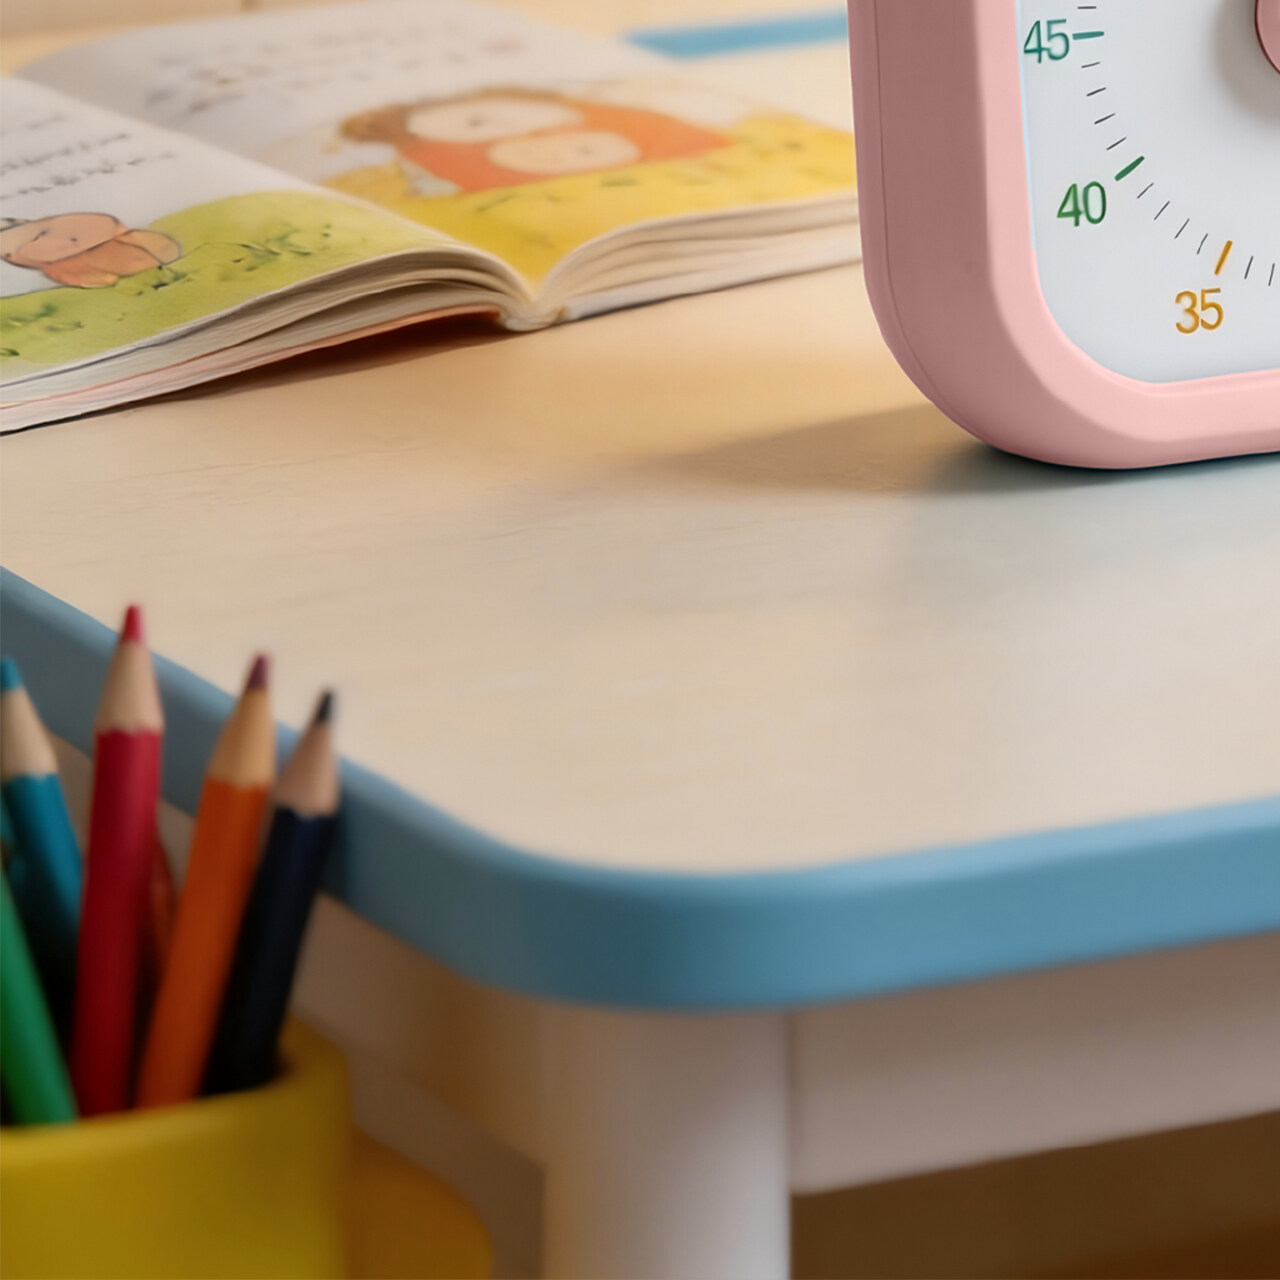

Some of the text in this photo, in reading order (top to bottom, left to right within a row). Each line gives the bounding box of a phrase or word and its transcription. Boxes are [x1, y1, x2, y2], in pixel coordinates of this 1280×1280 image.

[1024, 19, 1069, 63] 45
[1057, 182, 1106, 226] 40
[1175, 288, 1224, 334] 35
